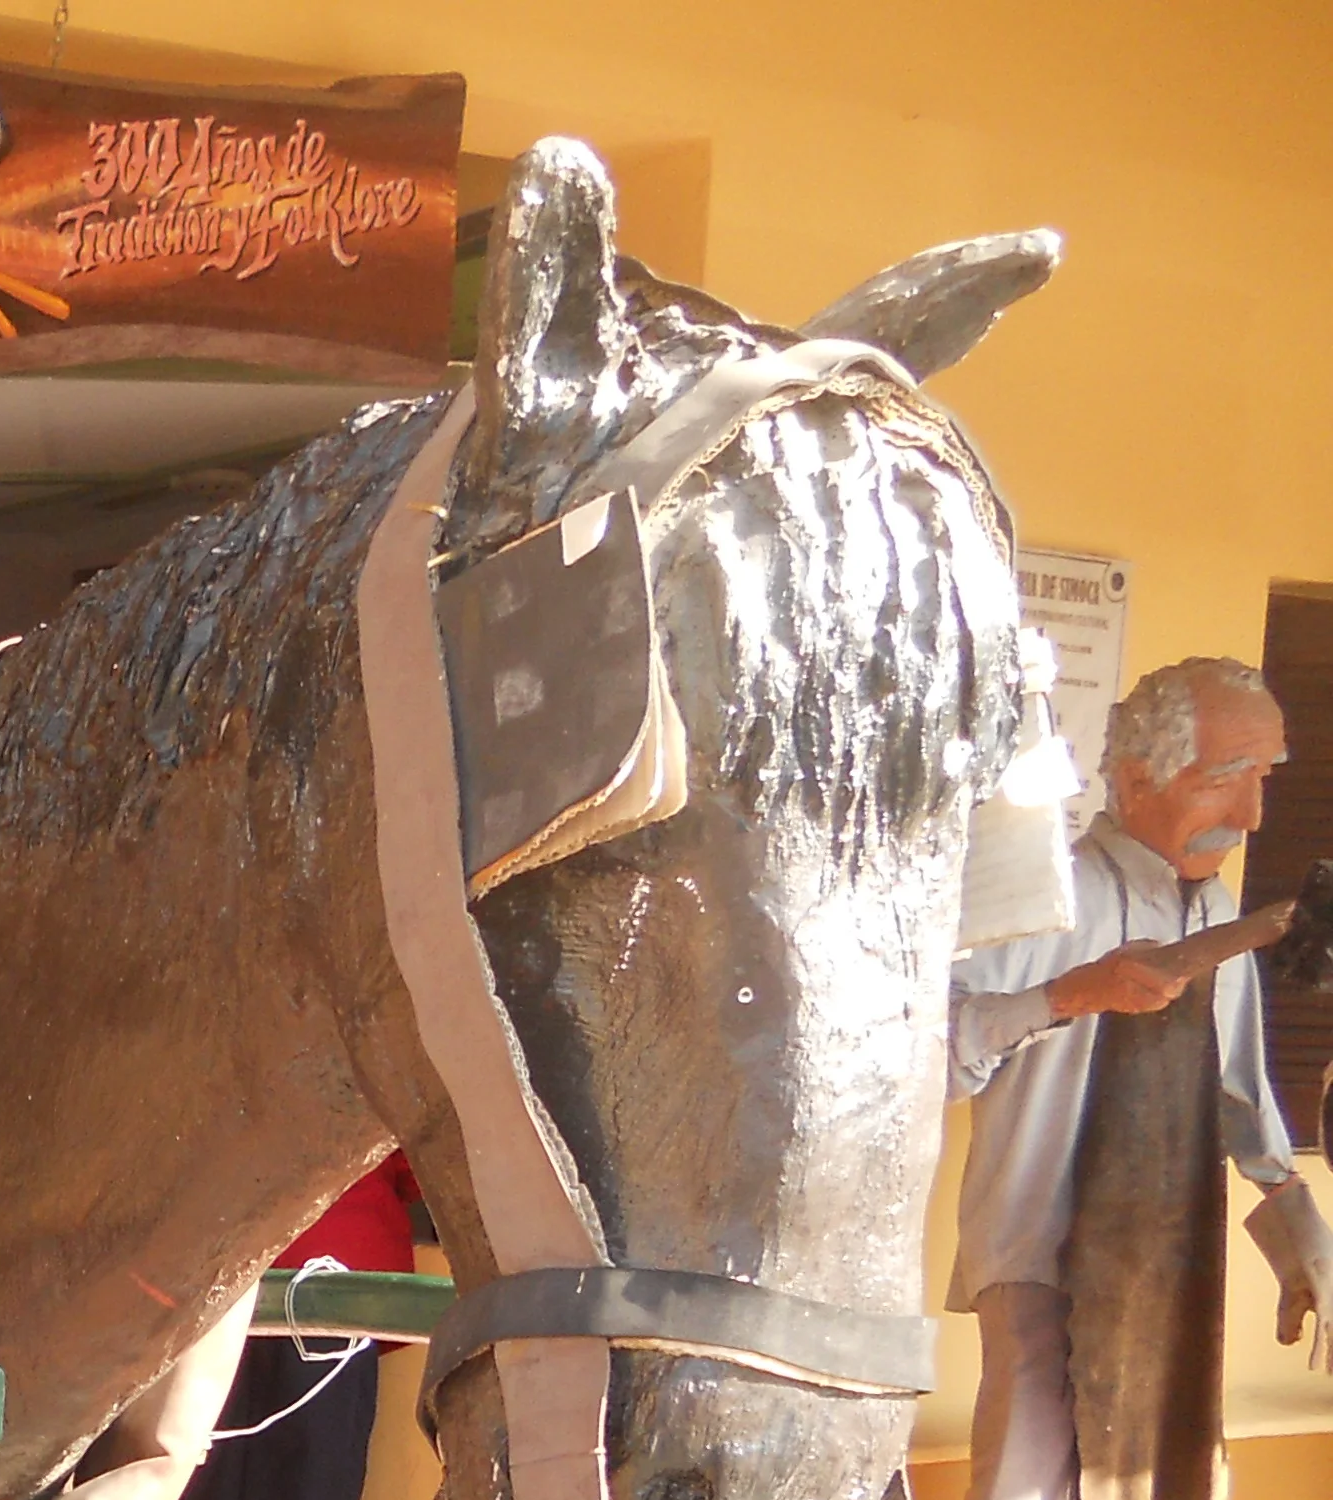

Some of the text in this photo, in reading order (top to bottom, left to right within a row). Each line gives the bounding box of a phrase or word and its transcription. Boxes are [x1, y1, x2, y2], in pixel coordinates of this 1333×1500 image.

[82, 115, 332, 200] 300 Años de
